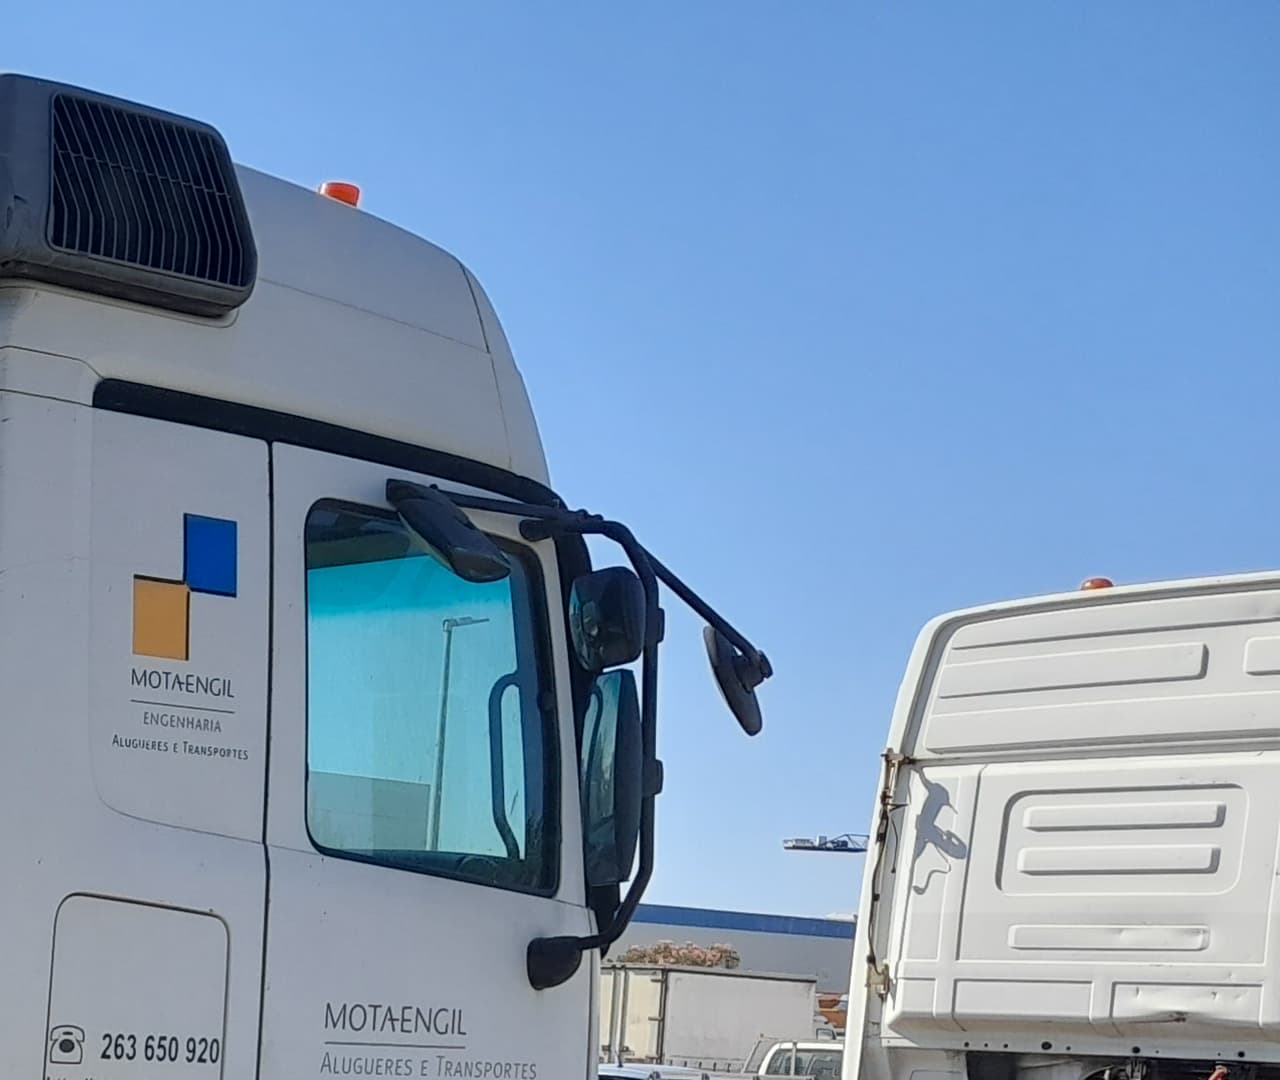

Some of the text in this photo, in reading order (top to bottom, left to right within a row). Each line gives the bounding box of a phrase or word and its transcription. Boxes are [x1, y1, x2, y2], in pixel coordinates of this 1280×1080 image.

[142, 711, 223, 733] ENGENHARIA
[111, 733, 169, 753] ALUGUERES
[183, 740, 249, 761] TRANSPORTES
[100, 1032, 221, 1064] 263 650 920
[319, 1050, 414, 1078] ALUGUERES
[435, 1054, 538, 1080] TRANSPORTES
